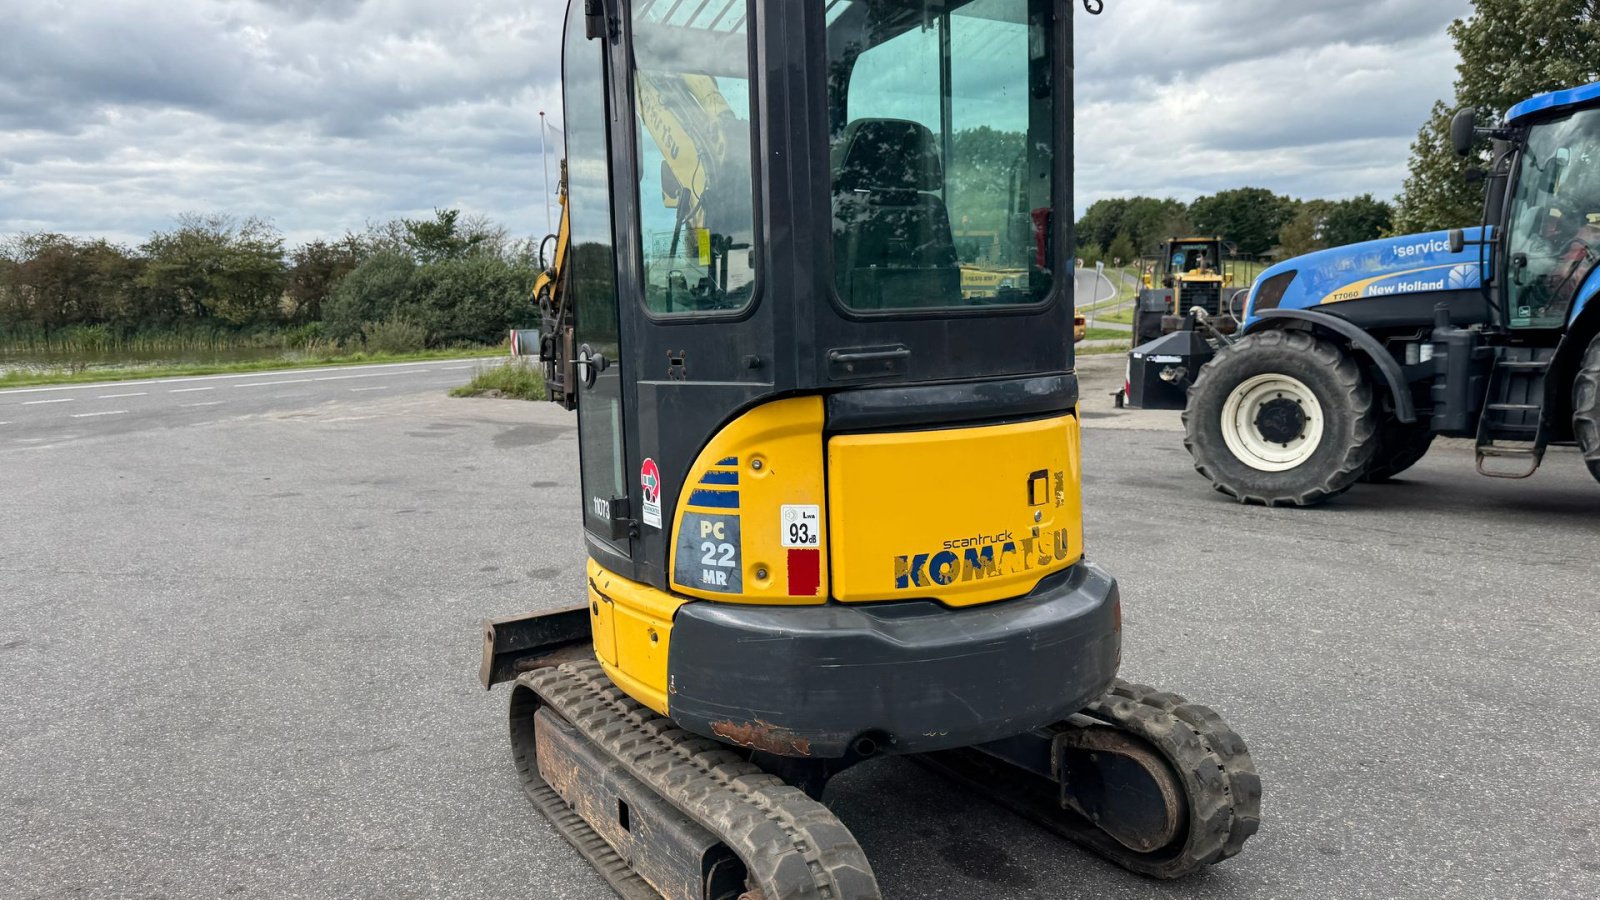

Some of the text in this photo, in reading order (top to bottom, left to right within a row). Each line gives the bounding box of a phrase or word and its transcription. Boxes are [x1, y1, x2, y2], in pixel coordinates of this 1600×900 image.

[1333, 290, 1359, 301] T7060
[1368, 279, 1444, 296] New Holland
[700, 520, 725, 540] PC
[789, 522, 808, 544] 93
[943, 530, 1013, 550] scantruck
[701, 541, 736, 568] 22
[702, 569, 728, 586] MR
